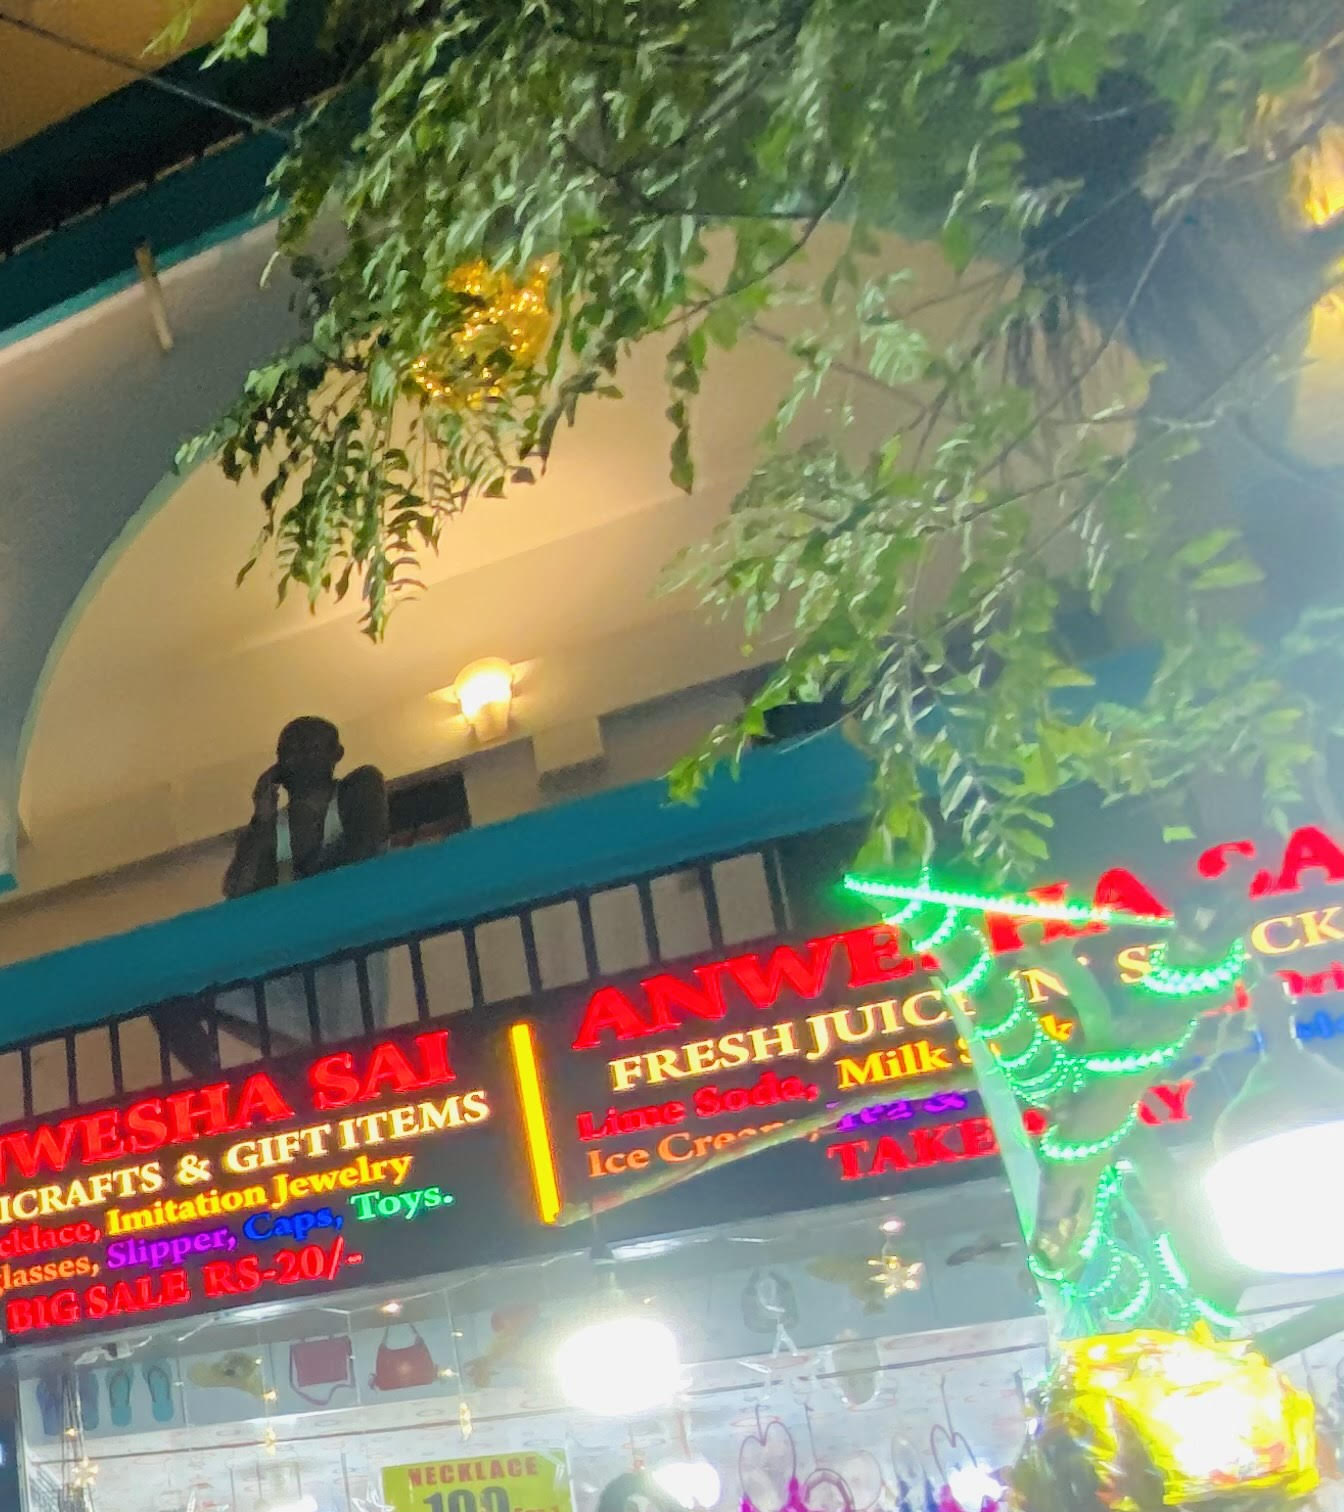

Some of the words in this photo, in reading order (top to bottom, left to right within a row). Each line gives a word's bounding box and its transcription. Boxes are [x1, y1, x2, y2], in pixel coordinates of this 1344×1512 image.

[312, 1030, 456, 1111] SAI
[576, 1098, 687, 1142] Lime
[693, 1071, 820, 1119] Soda,
[834, 1040, 952, 1090] Milk
[609, 1013, 799, 1093] FRESH
[176, 1155, 211, 1184] &
[224, 1124, 332, 1174] GIFT
[336, 1091, 491, 1147] ITEMS
[587, 1147, 650, 1178] Ice
[106, 1182, 267, 1237] Imitation
[271, 1153, 413, 1209] Jewelry
[106, 1225, 238, 1274] Slipper,
[243, 1207, 343, 1247] Caps,
[349, 1184, 455, 1226] Toys.
[7, 1290, 79, 1336] BIG
[87, 1272, 192, 1319] SALE
[206, 1236, 363, 1300] RS-20/-
[408, 1456, 538, 1487] NECKLACE
